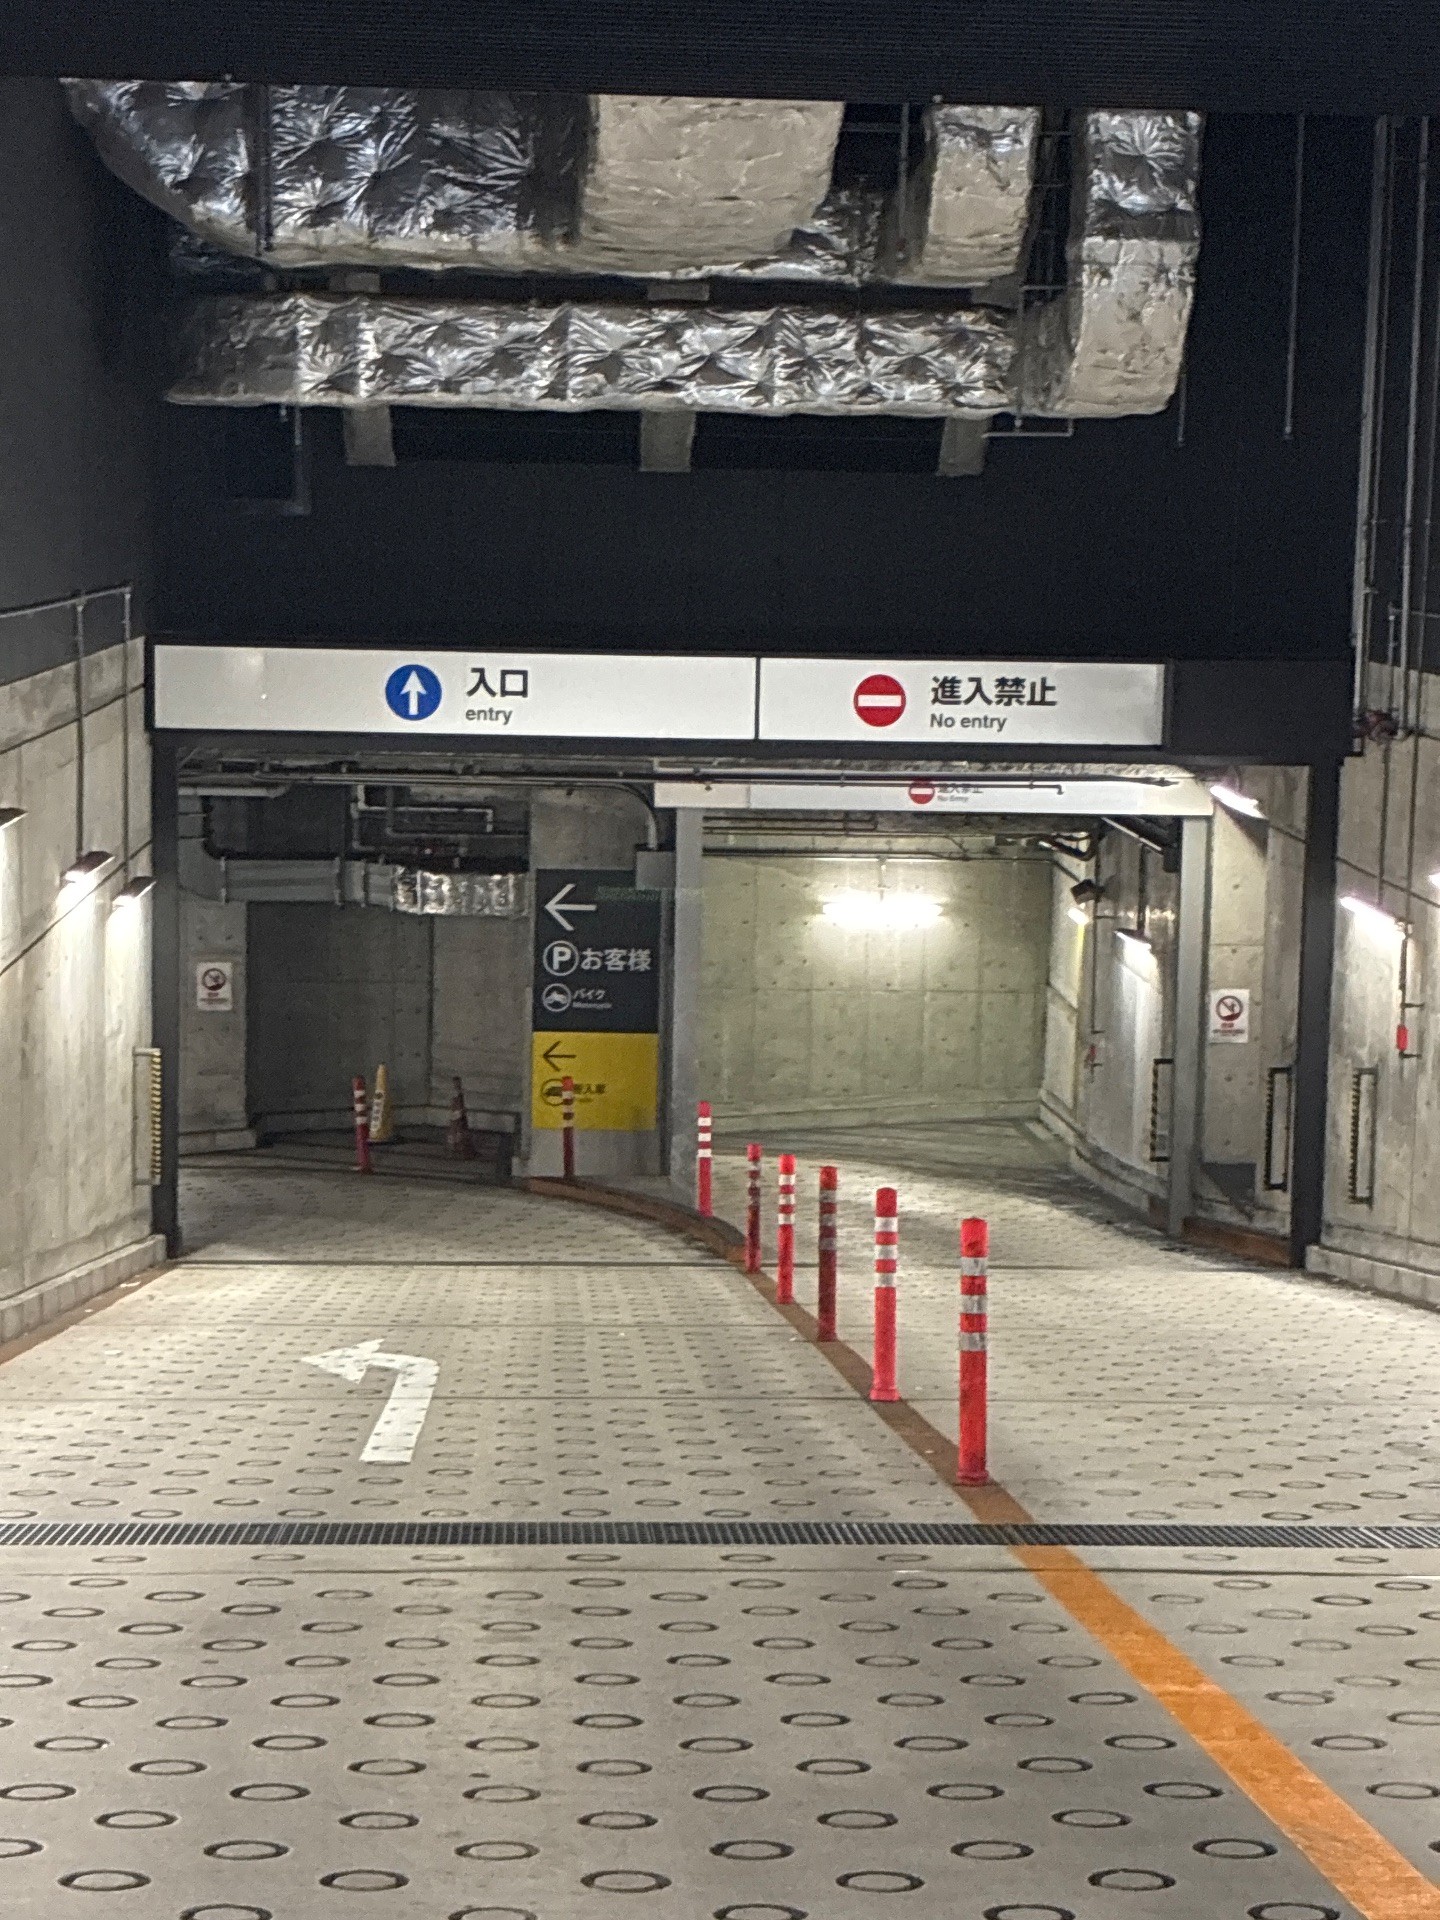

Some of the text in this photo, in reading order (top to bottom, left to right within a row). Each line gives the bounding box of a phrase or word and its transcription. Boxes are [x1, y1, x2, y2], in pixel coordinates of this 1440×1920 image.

[466, 667, 528, 698] 入口
[931, 676, 1058, 707] 進入禁止
[465, 707, 512, 725] entry
[930, 713, 1007, 732] No entry
[580, 947, 651, 971] お客様
[573, 987, 606, 1000] バイク
